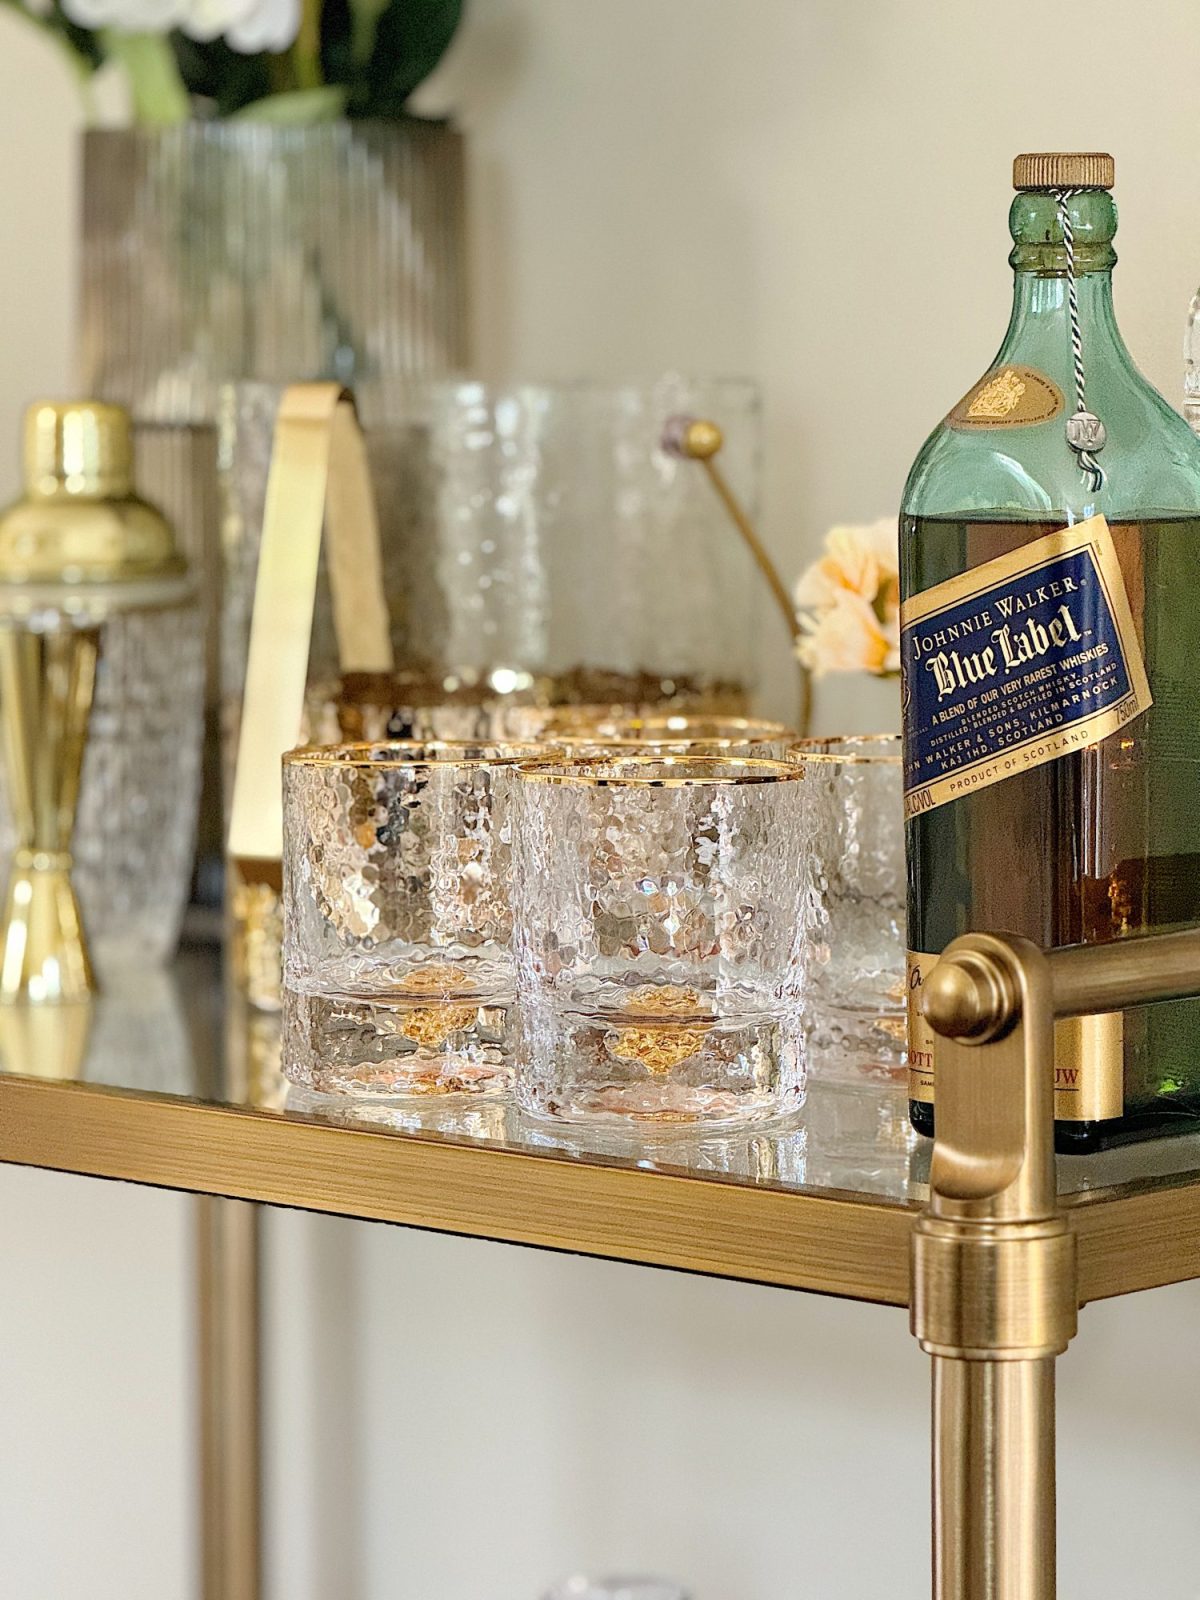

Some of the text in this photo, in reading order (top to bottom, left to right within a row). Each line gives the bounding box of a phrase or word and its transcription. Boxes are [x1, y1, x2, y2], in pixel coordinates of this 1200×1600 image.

[912, 577, 1079, 660] JOHNNIE WALKER
[925, 645, 998, 702] Blue
[991, 604, 1081, 674] Label
[931, 643, 1109, 726] A BLEND OF OUR VERY RAREST WHISKIES
[961, 705, 998, 725] BLENDED
[1001, 689, 1036, 708] SCOTCH
[973, 709, 1007, 728] BLENDED
[1009, 706, 1015, 714] &
[1017, 690, 1052, 710] BOTTLED
[1056, 687, 1066, 695] IN
[904, 676, 1117, 777] HN WALKER & SONS, KILMARNOCK
[941, 755, 962, 770] KA3
[998, 713, 1063, 746] SCOTLAND
[949, 766, 999, 792] PRODUCT
[1004, 759, 1017, 770] OF
[1023, 730, 1089, 763] SCOTLAND
